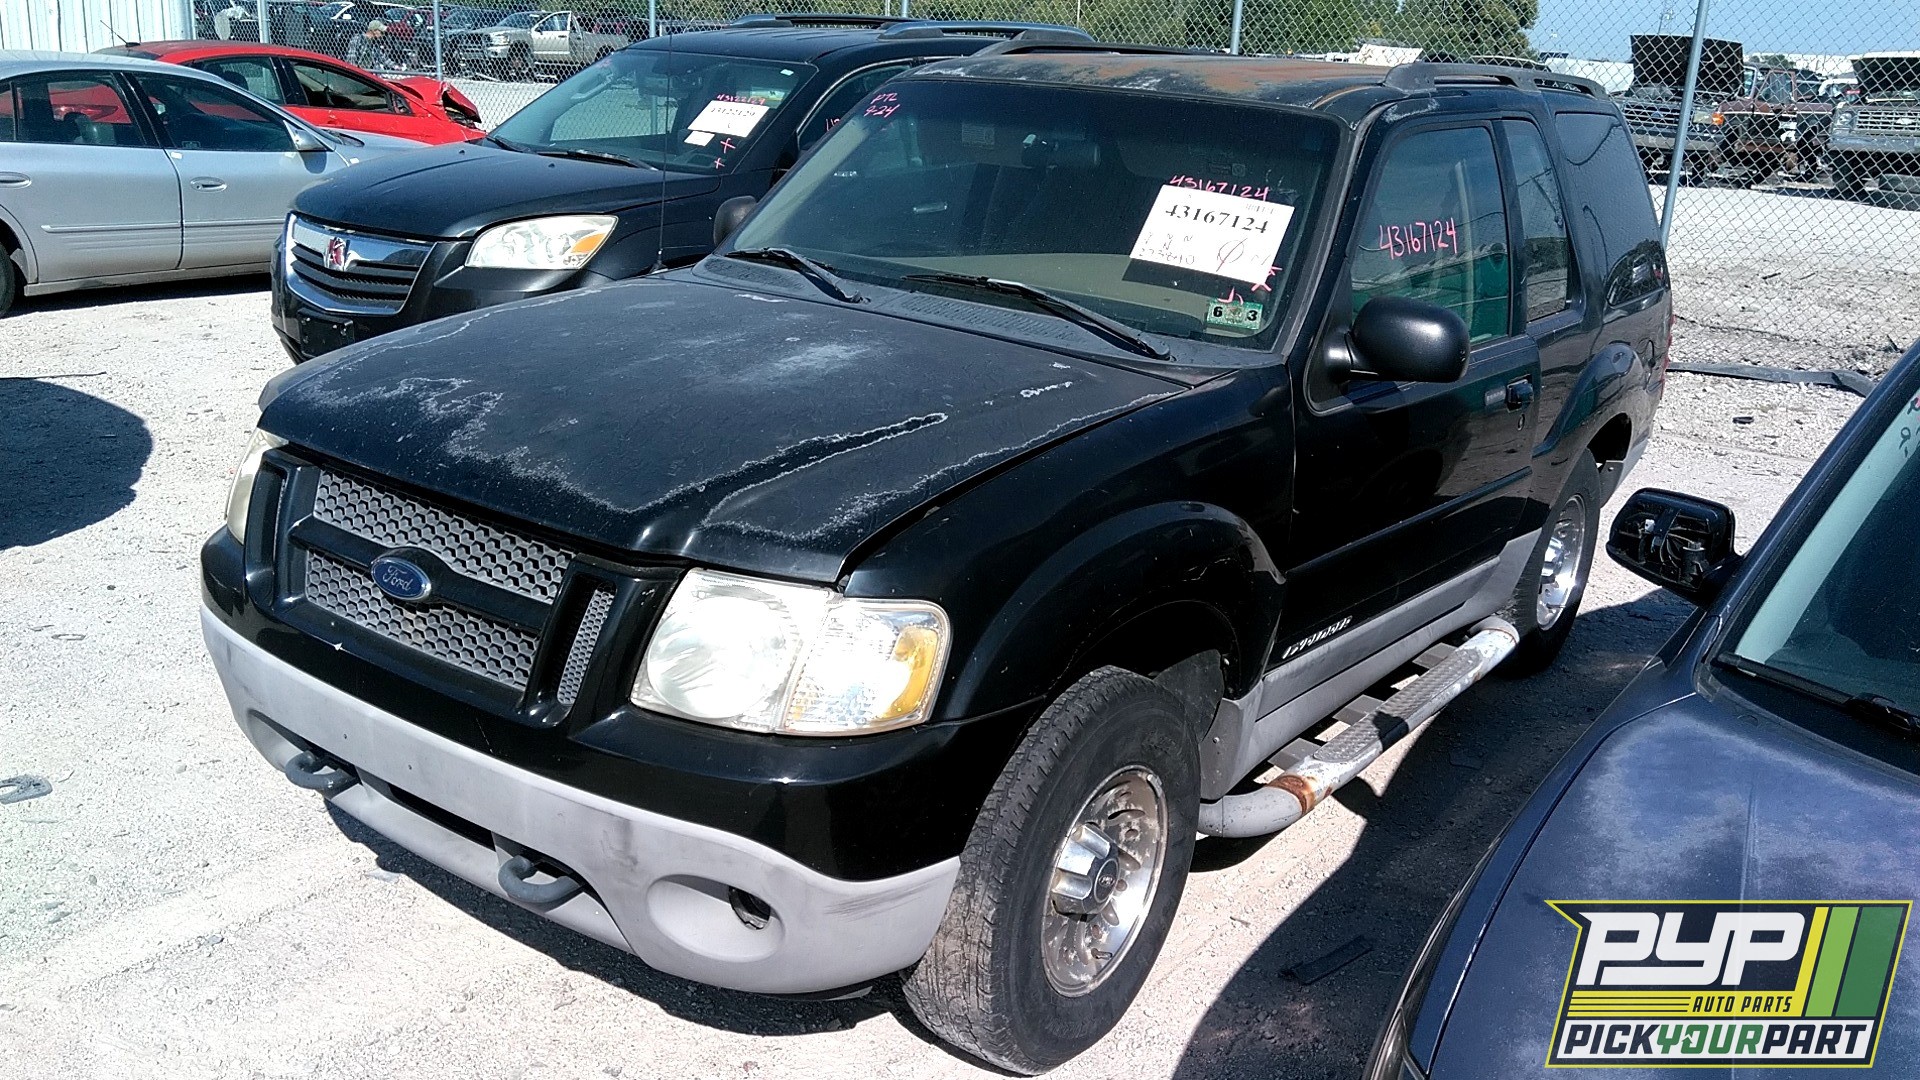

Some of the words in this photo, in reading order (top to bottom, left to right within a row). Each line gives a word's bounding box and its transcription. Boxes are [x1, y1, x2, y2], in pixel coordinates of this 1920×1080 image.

[1169, 174, 1271, 202] 43167124
[1165, 203, 1270, 234] 43167124
[1378, 216, 1458, 260] 43167124
[1212, 306, 1223, 318] 6
[1247, 309, 1258, 321] 3
[382, 565, 414, 591] Ford
